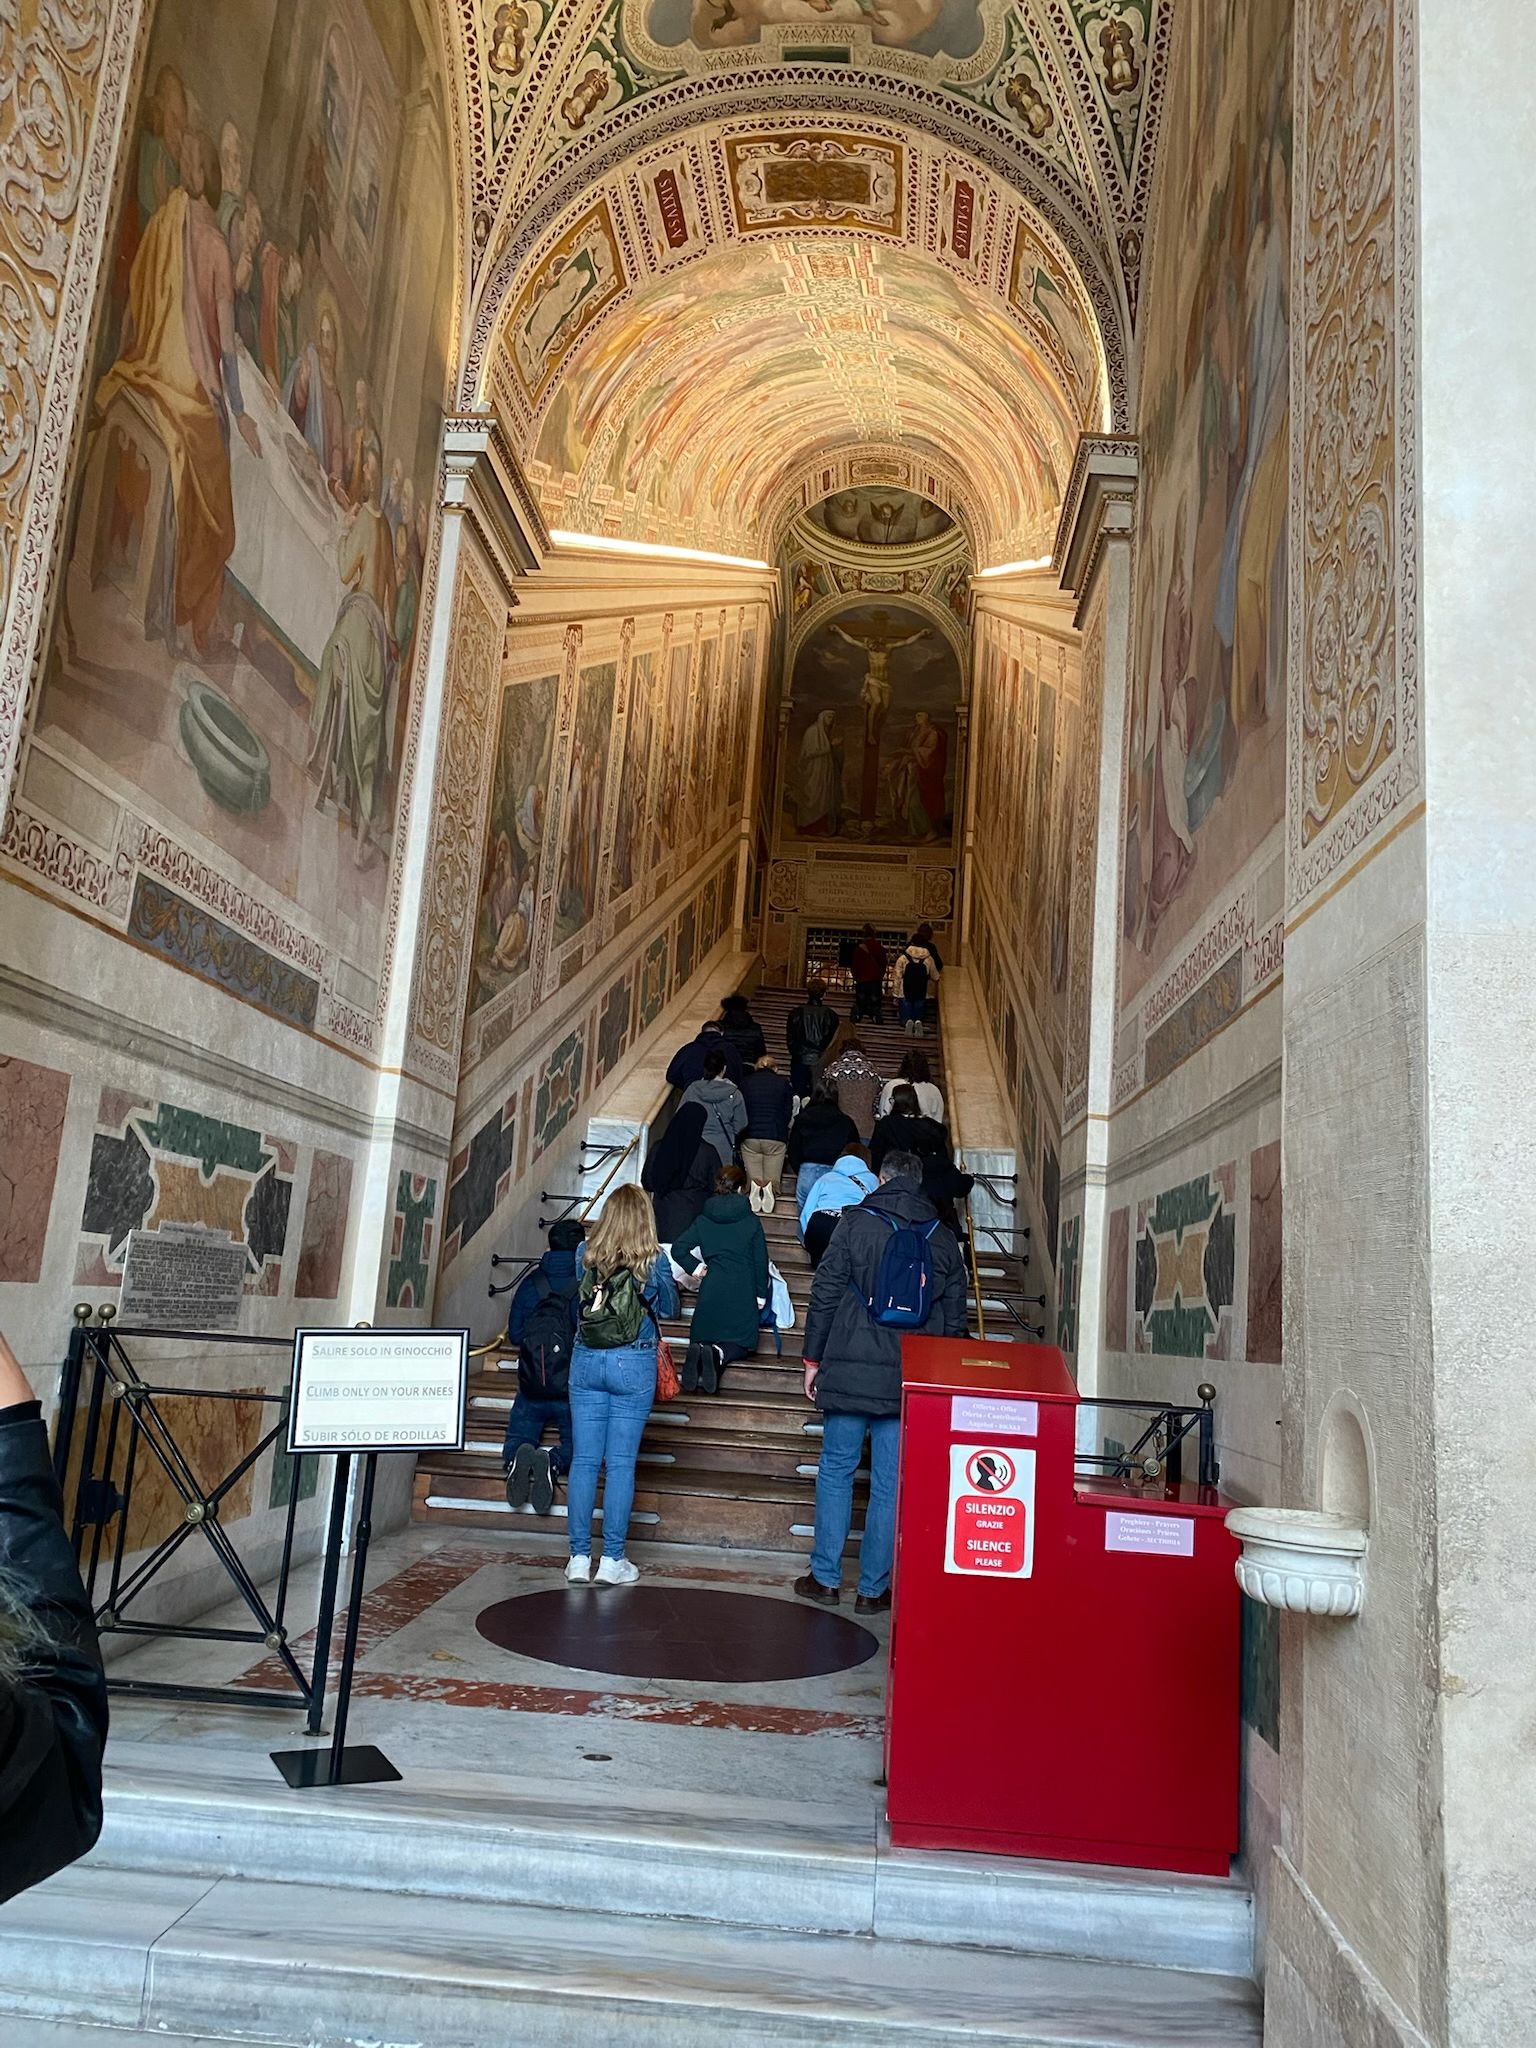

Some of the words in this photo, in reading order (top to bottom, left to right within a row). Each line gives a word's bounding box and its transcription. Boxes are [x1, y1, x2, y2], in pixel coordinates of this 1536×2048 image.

[312, 1345, 347, 1356] SALIRE
[350, 1346, 377, 1356] SOLO
[380, 1346, 392, 1356] IN
[394, 1346, 452, 1356] GINOCCHIO
[306, 1386, 339, 1397] CLIMB
[342, 1386, 369, 1397] ONLY
[372, 1386, 388, 1397] ON
[390, 1386, 419, 1397] YOUR
[422, 1386, 453, 1397] KNEES
[302, 1430, 337, 1441] SUBIR
[341, 1428, 371, 1441] SÓLO
[375, 1430, 389, 1441] DE
[392, 1430, 446, 1440] RODILLAS
[965, 1502, 1016, 1517] SILENZIO
[975, 1519, 1005, 1530] GRAZIE
[967, 1539, 1012, 1553] SILENCE
[975, 1557, 1003, 1568] PLEASE
